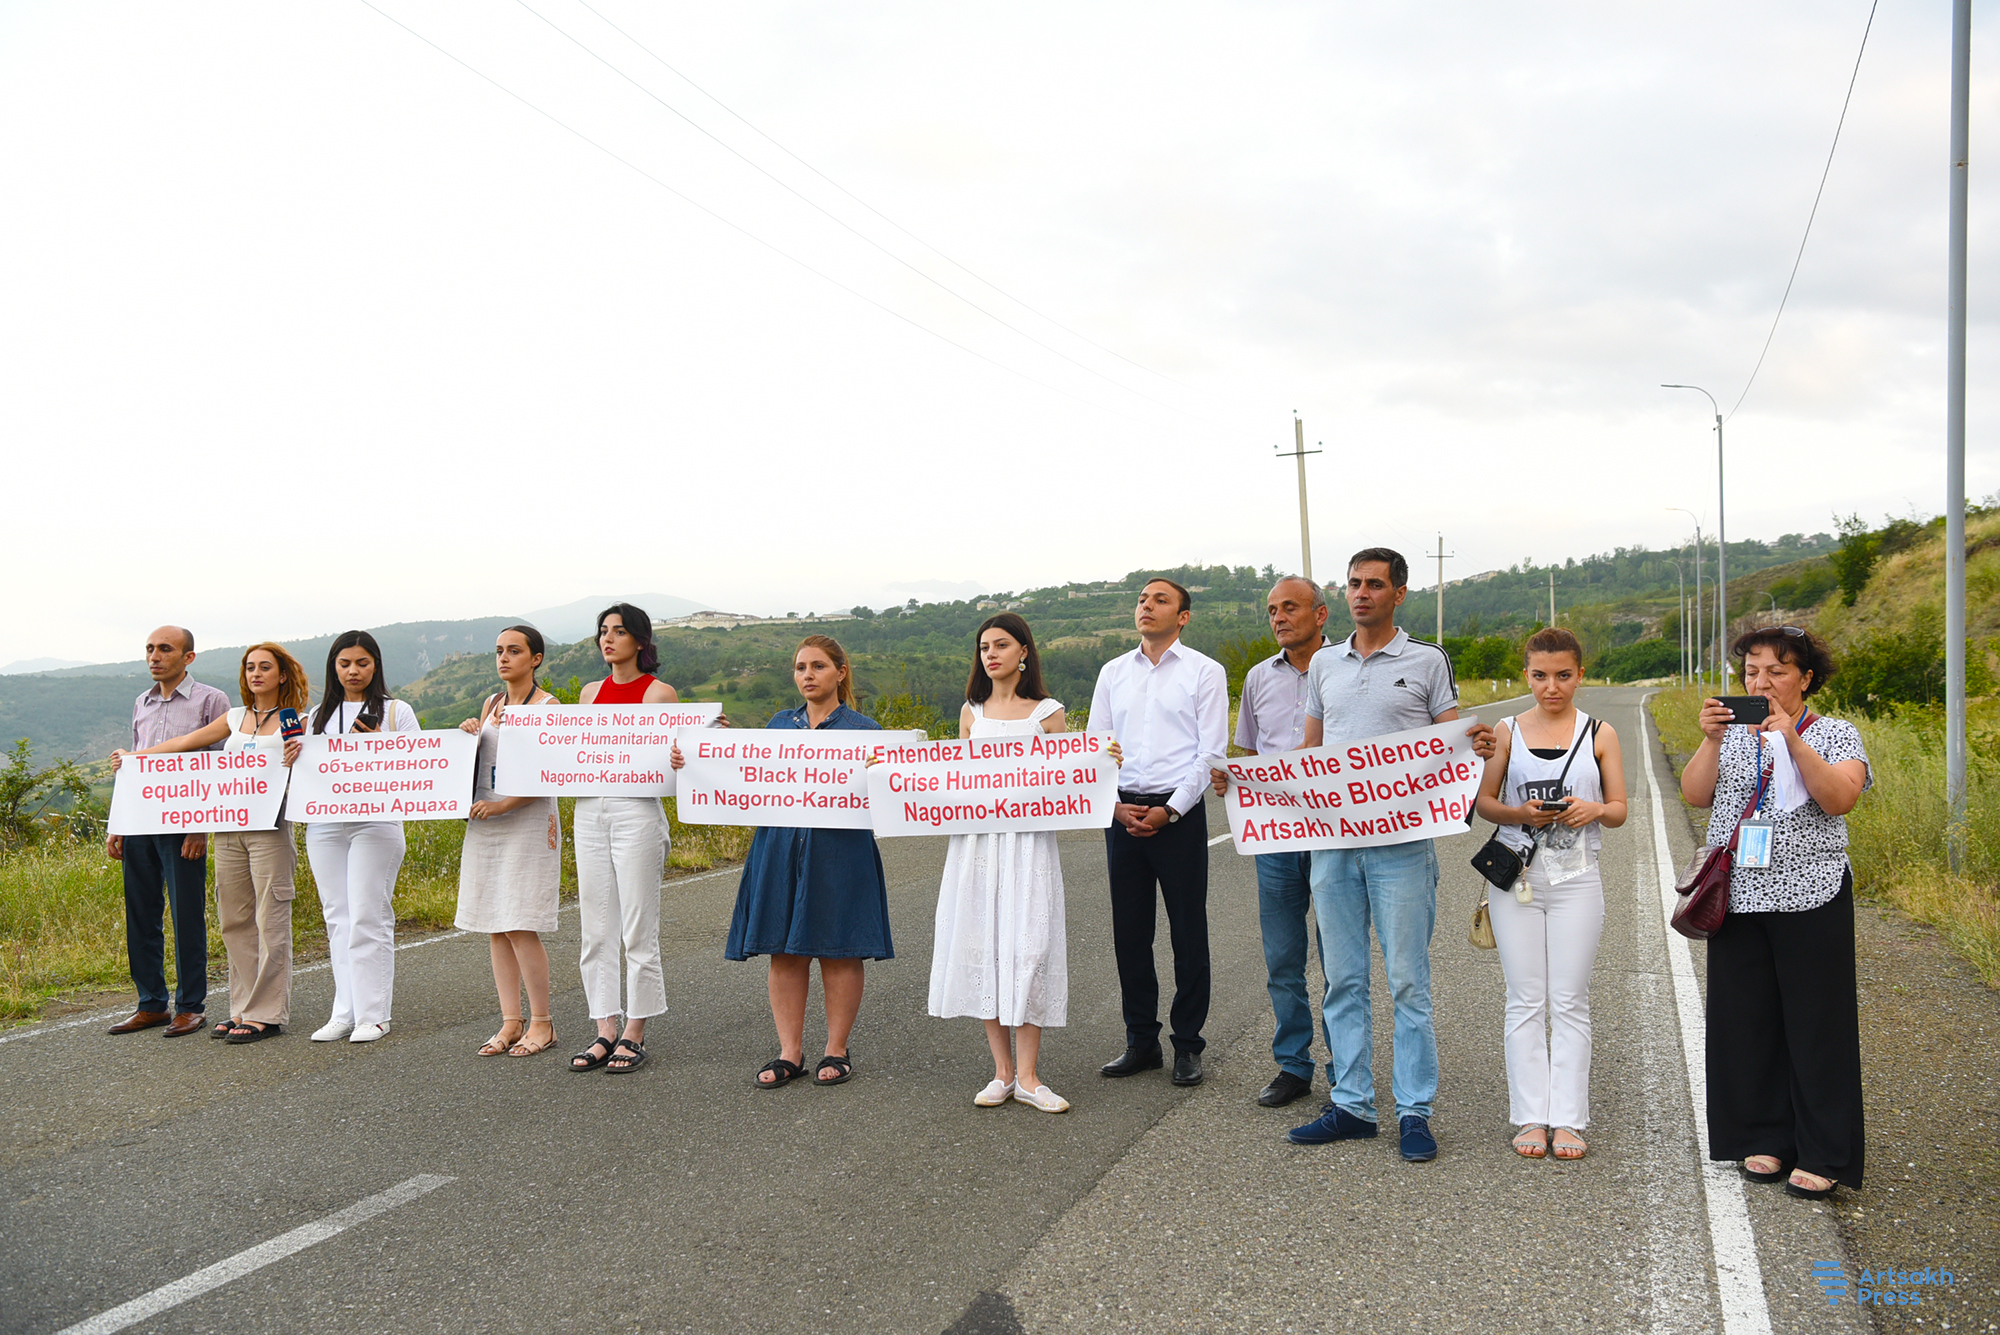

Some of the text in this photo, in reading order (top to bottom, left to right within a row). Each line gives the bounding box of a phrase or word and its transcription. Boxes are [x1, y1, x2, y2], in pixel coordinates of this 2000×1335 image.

[505, 713, 705, 729] Media Silence is Not an Option:
[329, 735, 441, 754] Мы требуем
[539, 732, 668, 745] Cover Humanitarian
[577, 751, 630, 764] Crisis in
[699, 743, 736, 759] End
[742, 743, 772, 759] the
[874, 742, 963, 764] Entendez
[969, 740, 1024, 759] Leurs
[1031, 733, 1099, 760] Appels
[136, 751, 267, 773] Treat all sides
[319, 759, 449, 773] объективного
[1228, 737, 1454, 783] Break the Silence,
[541, 770, 664, 786] Nagorno-Karabakh
[740, 766, 853, 784] 'Black Hole'
[889, 766, 1097, 792] Crise Humanitaire au
[142, 777, 268, 802] equally while
[332, 780, 433, 793] освещения
[1238, 761, 1477, 809] Break the Blockade:
[693, 789, 708, 805] in
[306, 798, 457, 815] блокады Арцаха
[904, 794, 1091, 826] Nagorno-Karabakh
[162, 805, 249, 828] reporting
[1242, 794, 1475, 842] Artsakh Awaits Hel
